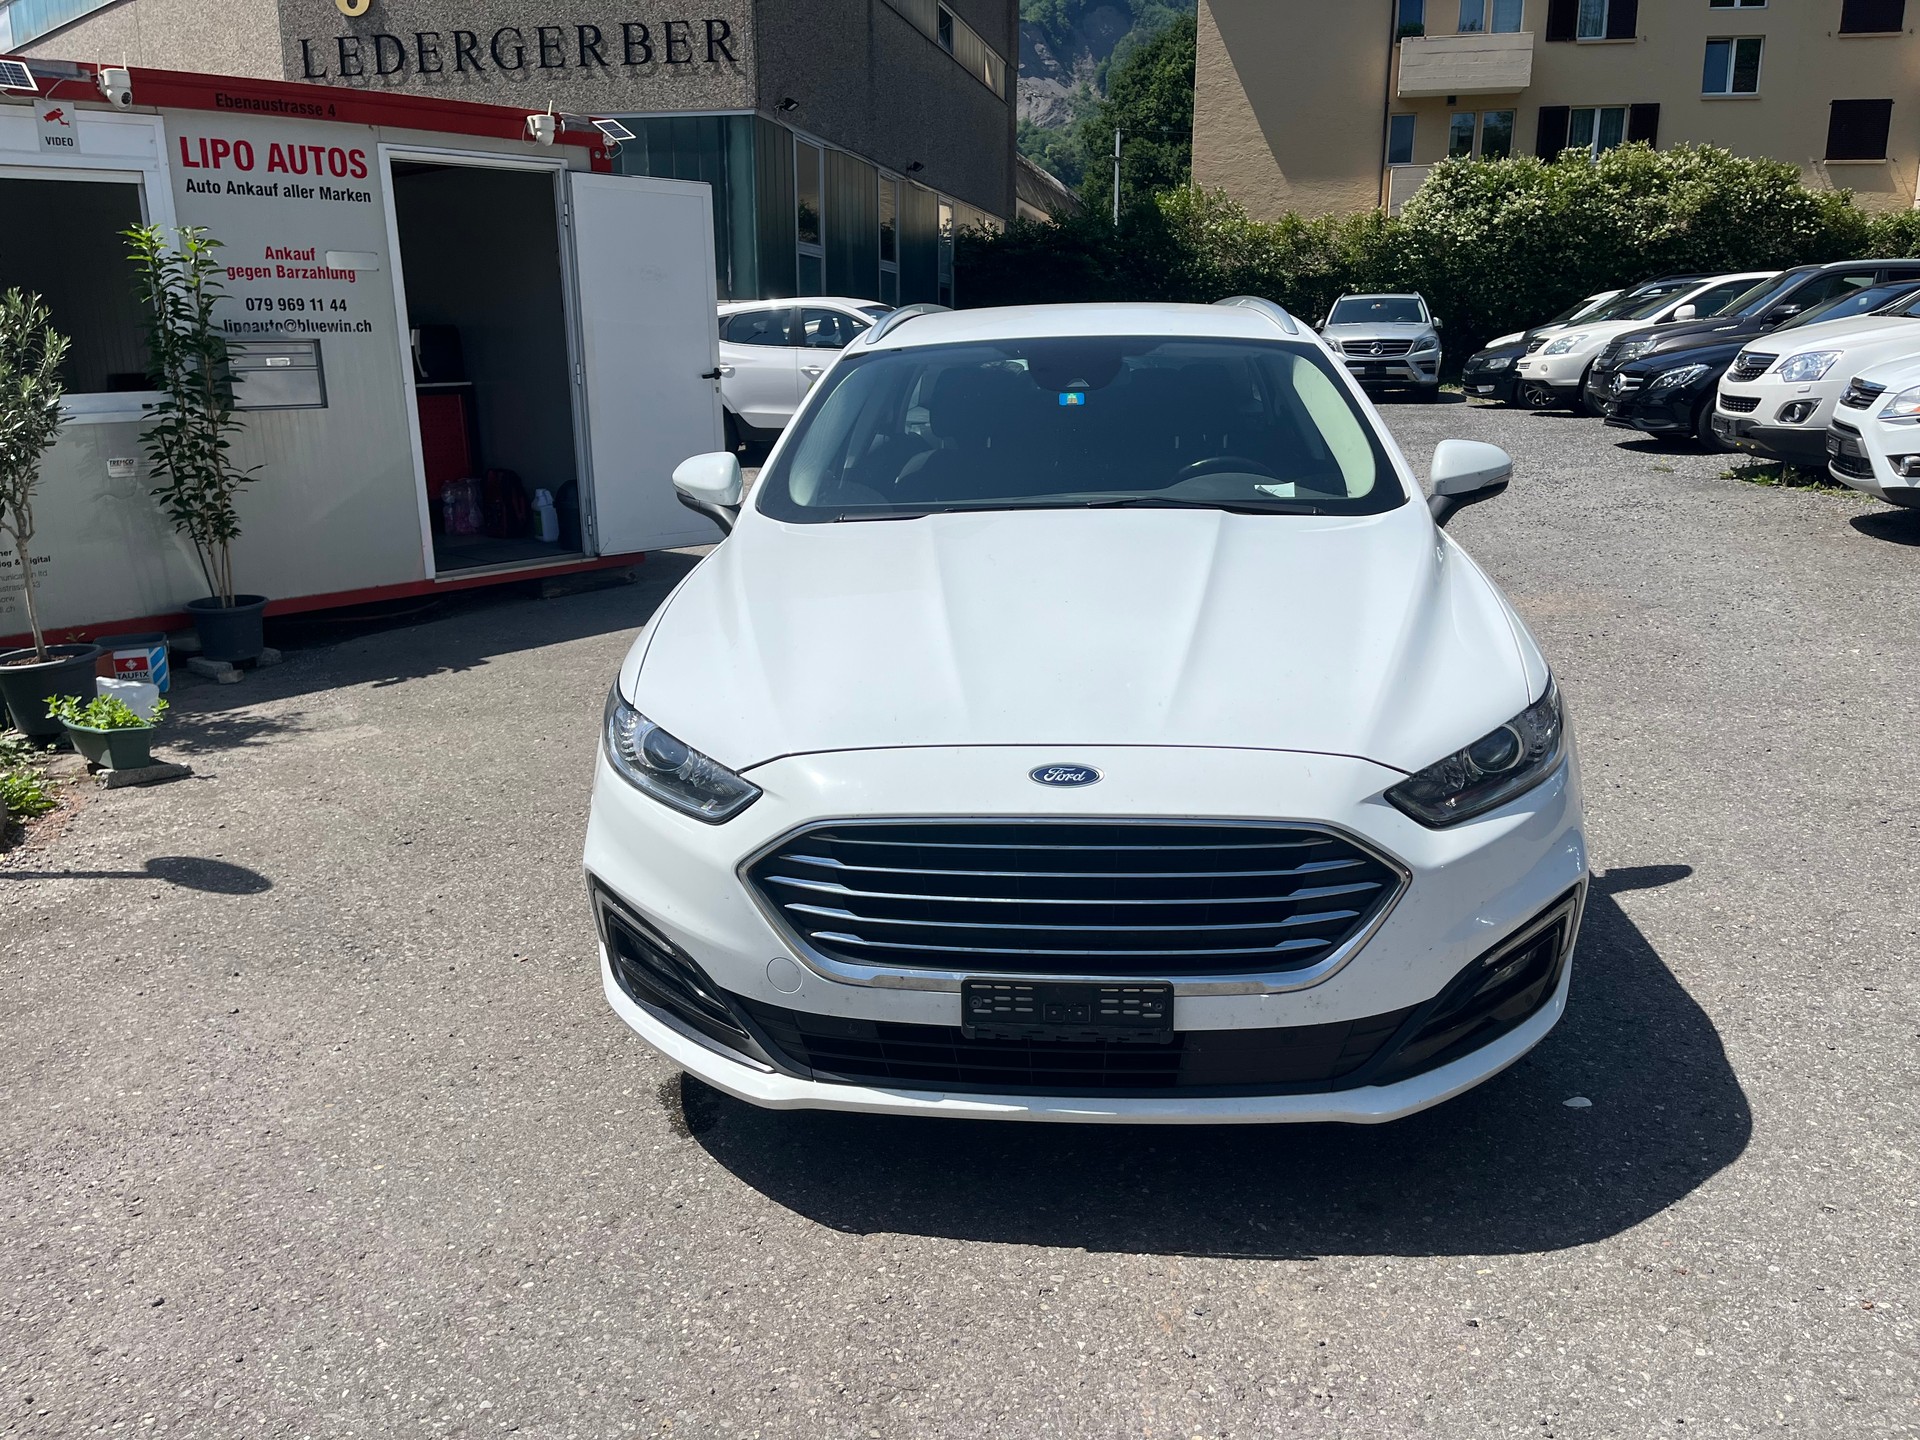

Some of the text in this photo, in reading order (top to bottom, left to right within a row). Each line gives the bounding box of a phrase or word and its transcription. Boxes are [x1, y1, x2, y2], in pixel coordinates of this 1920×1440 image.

[300, 19, 739, 80] LEDERGERBER
[215, 93, 337, 118] Ebenaustrasse 4
[45, 136, 74, 147] VIDEO
[179, 136, 368, 179] LIPO AUTOS
[186, 178, 372, 203] Auto Ankauf aller Marken
[265, 246, 316, 261] Ankauf
[226, 265, 356, 283] gegen Barzahlung
[245, 297, 347, 312] 079 969 11 44
[223, 319, 373, 336] lipoauto@bluewin.ch
[29, 555, 51, 565] igital
[116, 670, 150, 680] TAUFIX
[1043, 767, 1087, 781] Ford
